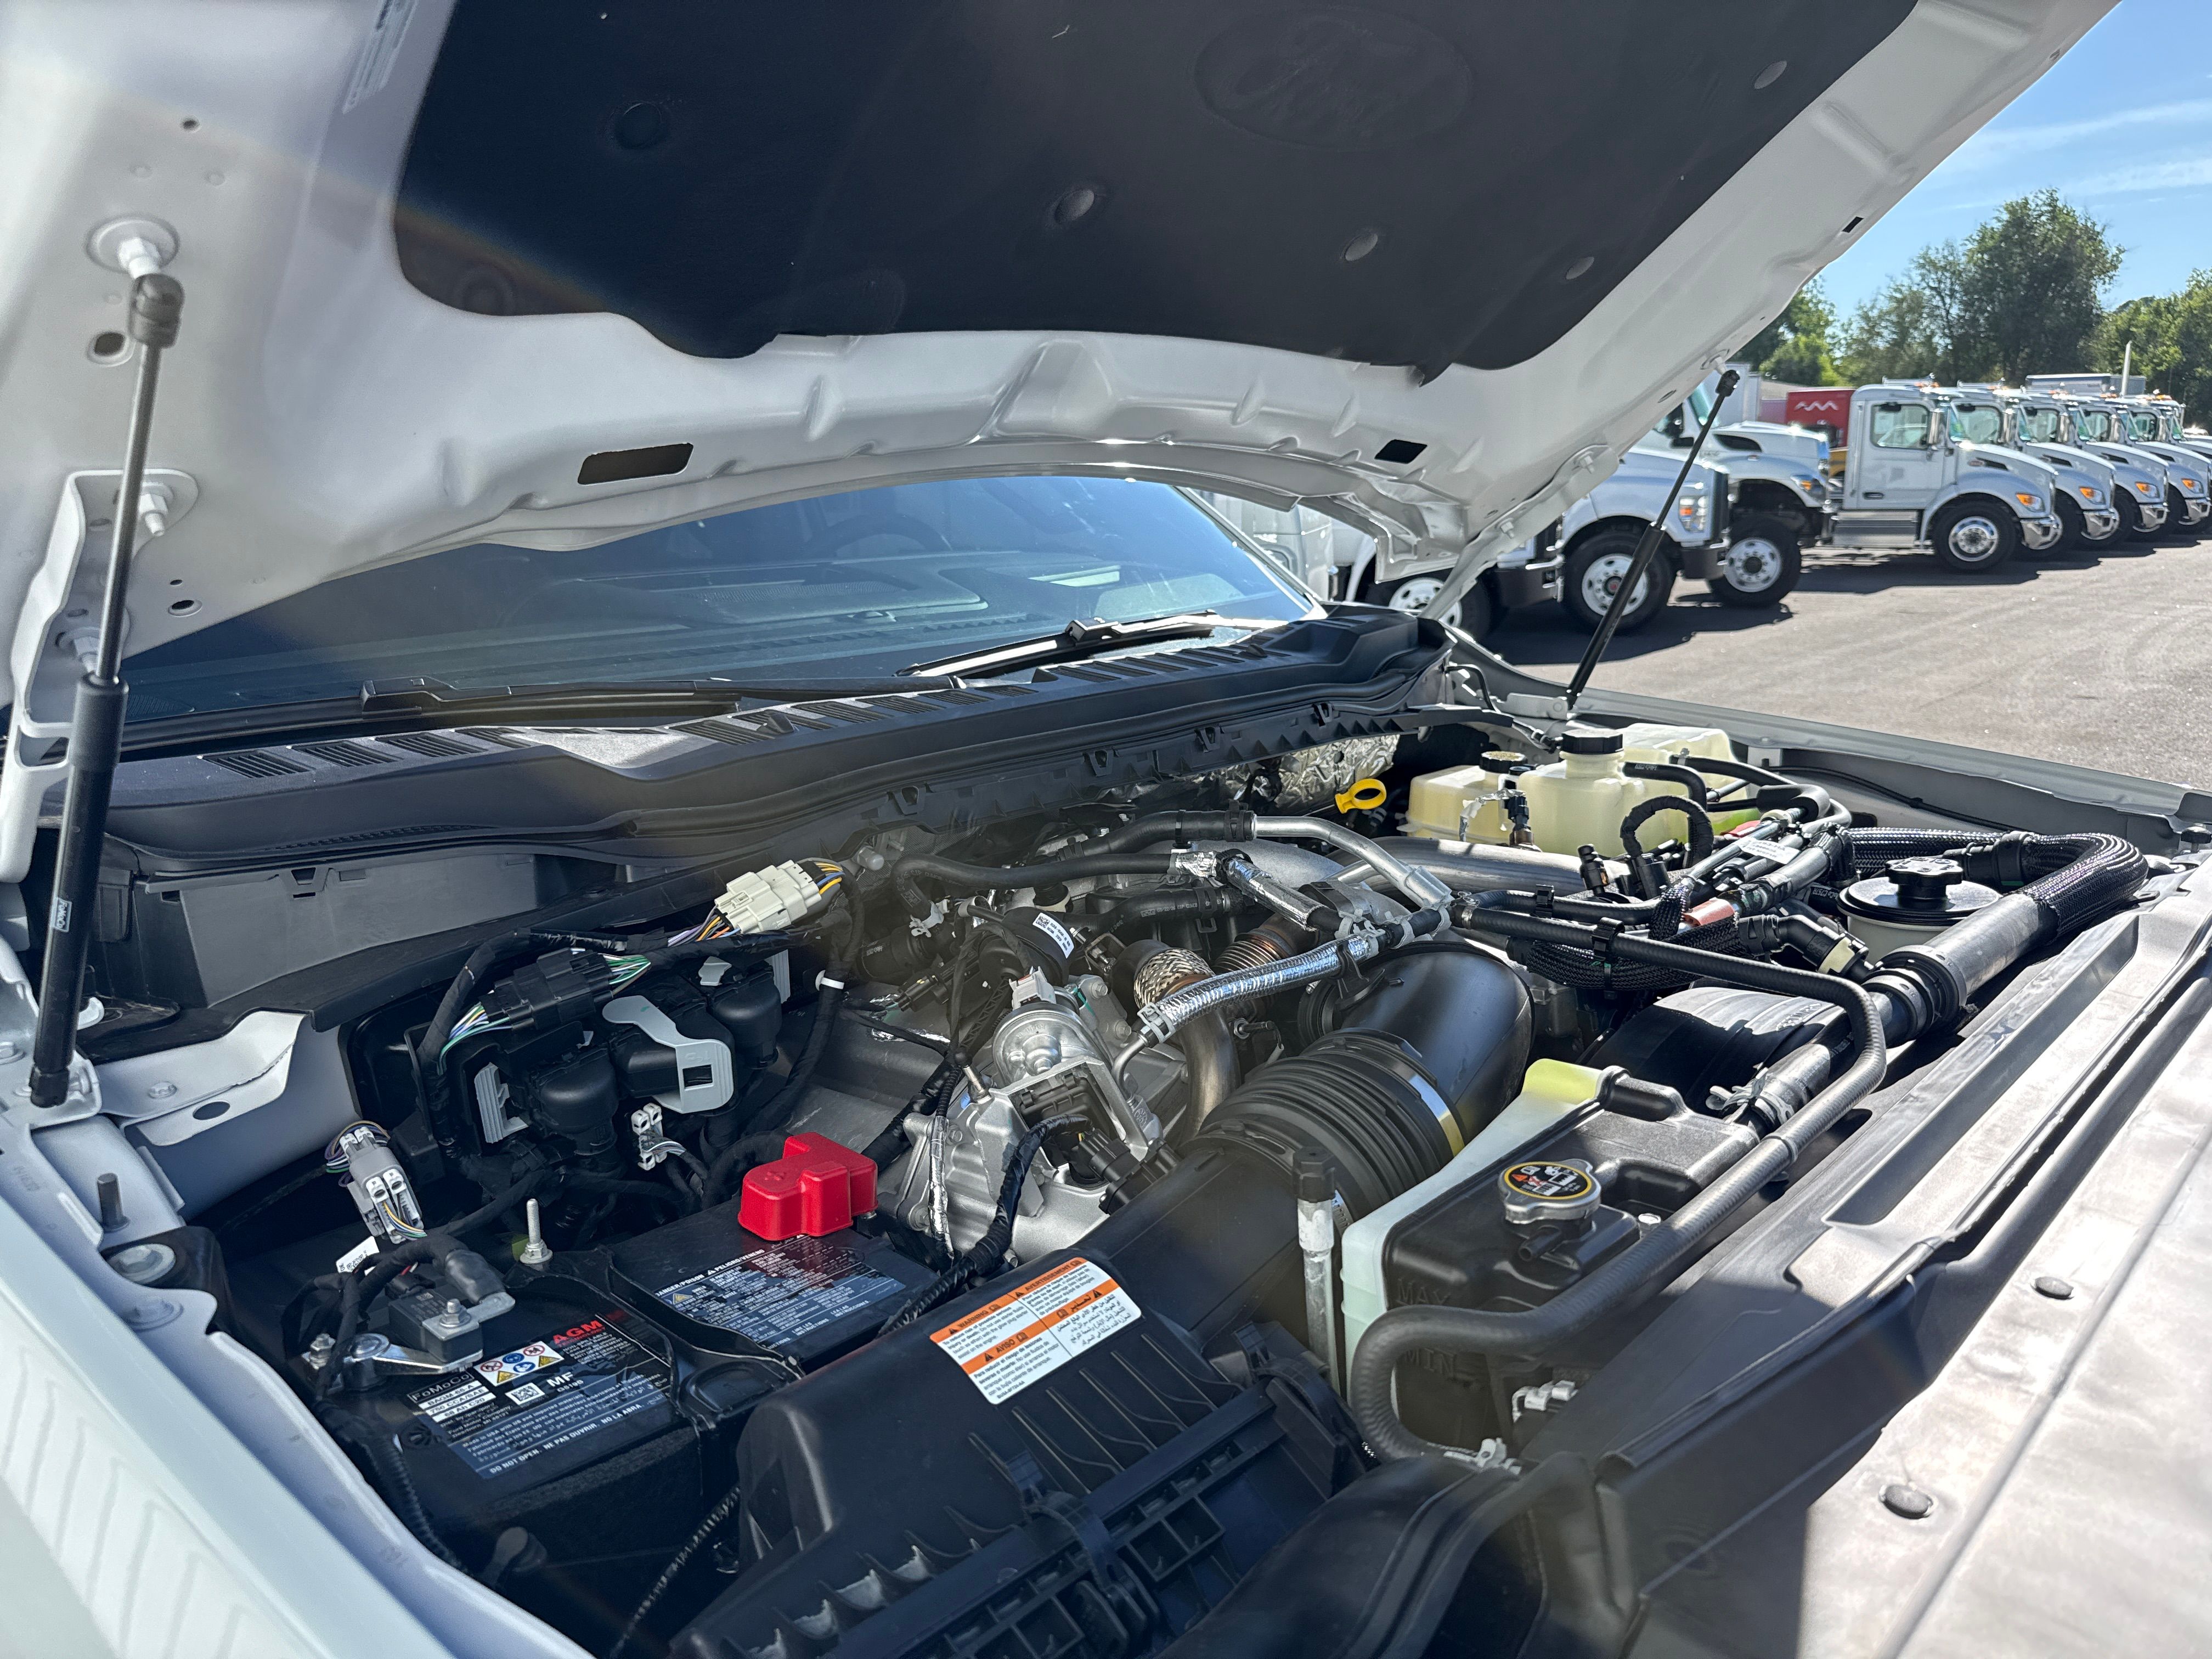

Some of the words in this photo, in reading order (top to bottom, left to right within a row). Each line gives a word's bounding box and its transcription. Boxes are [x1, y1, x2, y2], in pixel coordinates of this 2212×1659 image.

[714, 1249, 764, 1271] PELIGRO/VENENO
[1025, 1265, 1070, 1290] AVERTISSEMENT
[1026, 1295, 1041, 1305] graves
[1049, 1294, 1063, 1303] moteur
[949, 1332, 964, 1342] reduce
[978, 1315, 996, 1327] possible
[995, 1306, 1012, 1316] serious
[957, 1310, 989, 1327] WARNING
[1015, 1310, 1028, 1318] starter
[553, 1320, 602, 1345] AGM
[947, 1341, 961, 1350] injury
[1001, 1311, 1013, 1320] starter
[984, 1361, 1001, 1372] reducir
[1005, 1351, 1019, 1360] riesgo
[1024, 1337, 1042, 1348] lesiones
[996, 1339, 1015, 1353] AVISO
[979, 1372, 996, 1384] severas
[1029, 1344, 1044, 1353] fluidos
[411, 1374, 469, 1400] FoMoCo
[546, 1372, 573, 1386] MF
[430, 1405, 445, 1414] 750
[446, 1389, 484, 1407] CCA/SAE
[468, 1397, 485, 1406] C20
[462, 1438, 479, 1447] Made
[533, 1403, 557, 1416] imported
[501, 1458, 518, 1468] NOT
[517, 1448, 541, 1461] OPEN.
[554, 1435, 569, 1444] PAS
